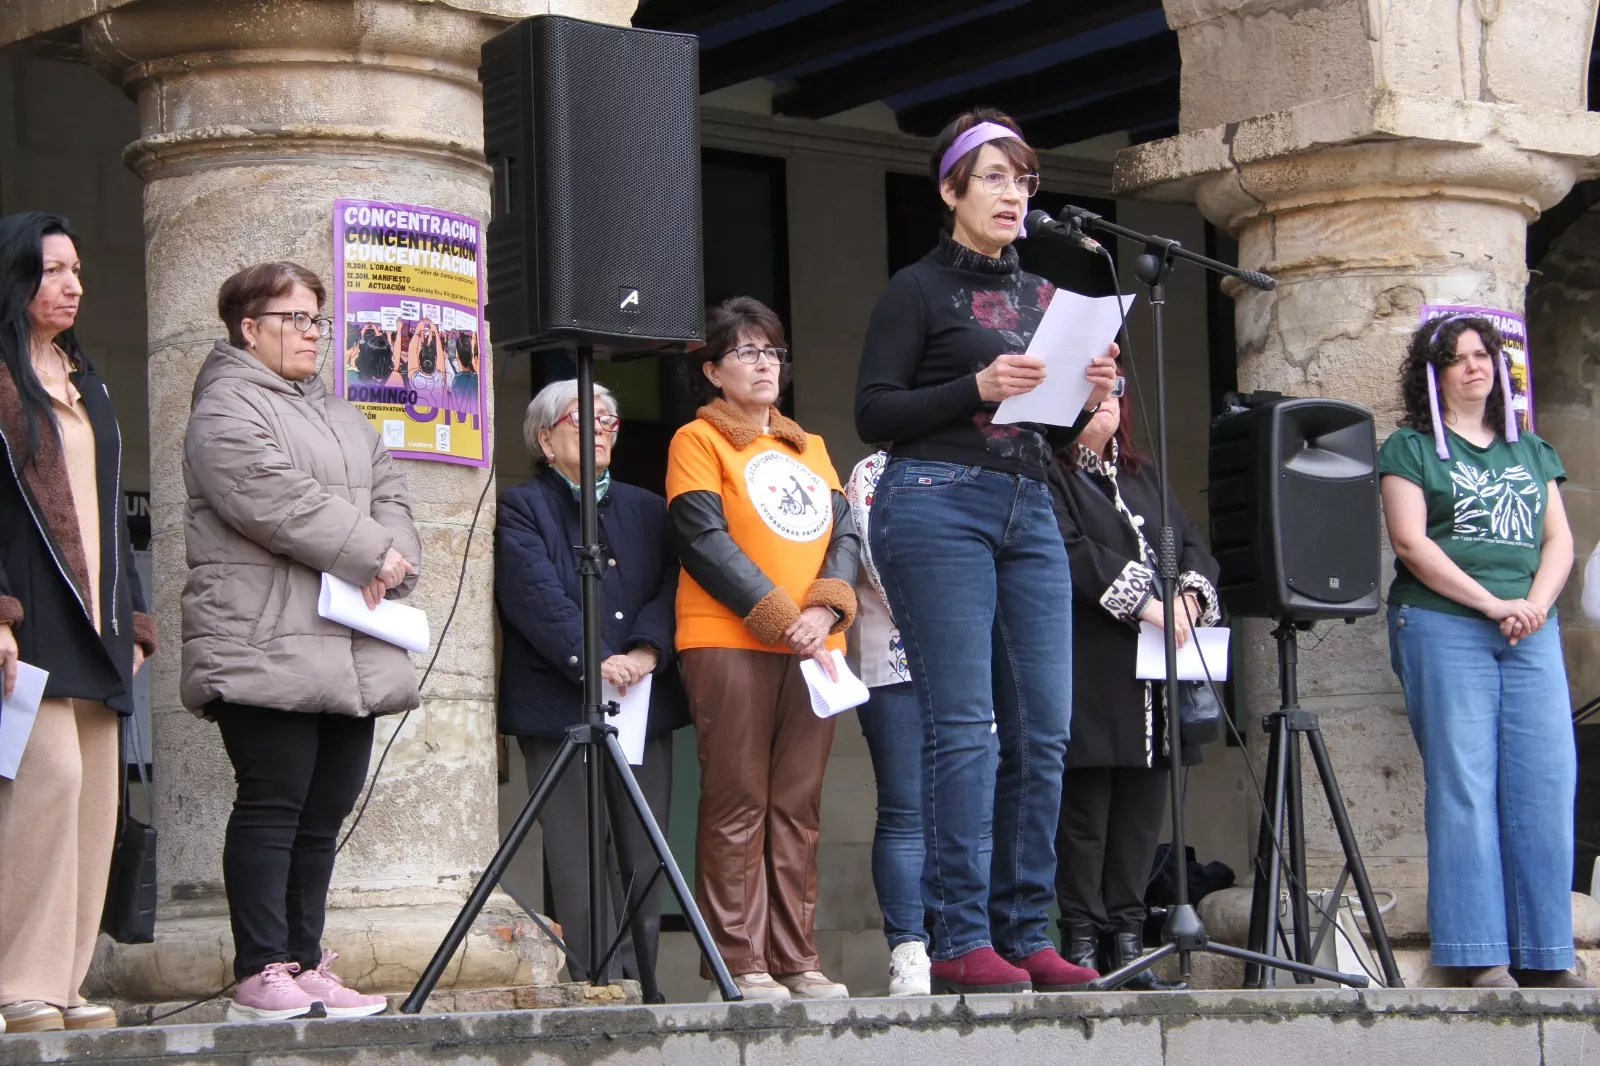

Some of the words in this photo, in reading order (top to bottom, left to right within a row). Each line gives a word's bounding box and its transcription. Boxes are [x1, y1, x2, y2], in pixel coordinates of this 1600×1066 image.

[344, 207, 476, 243] CONCENTRACIÓN
[345, 227, 476, 262] CONCENTRACIÓN
[368, 282, 406, 291] ACTUACIÓN
[372, 274, 410, 284] MANIFIESTO
[348, 386, 417, 405] DOMINGO
[760, 502, 800, 536] CUIDADORAS
